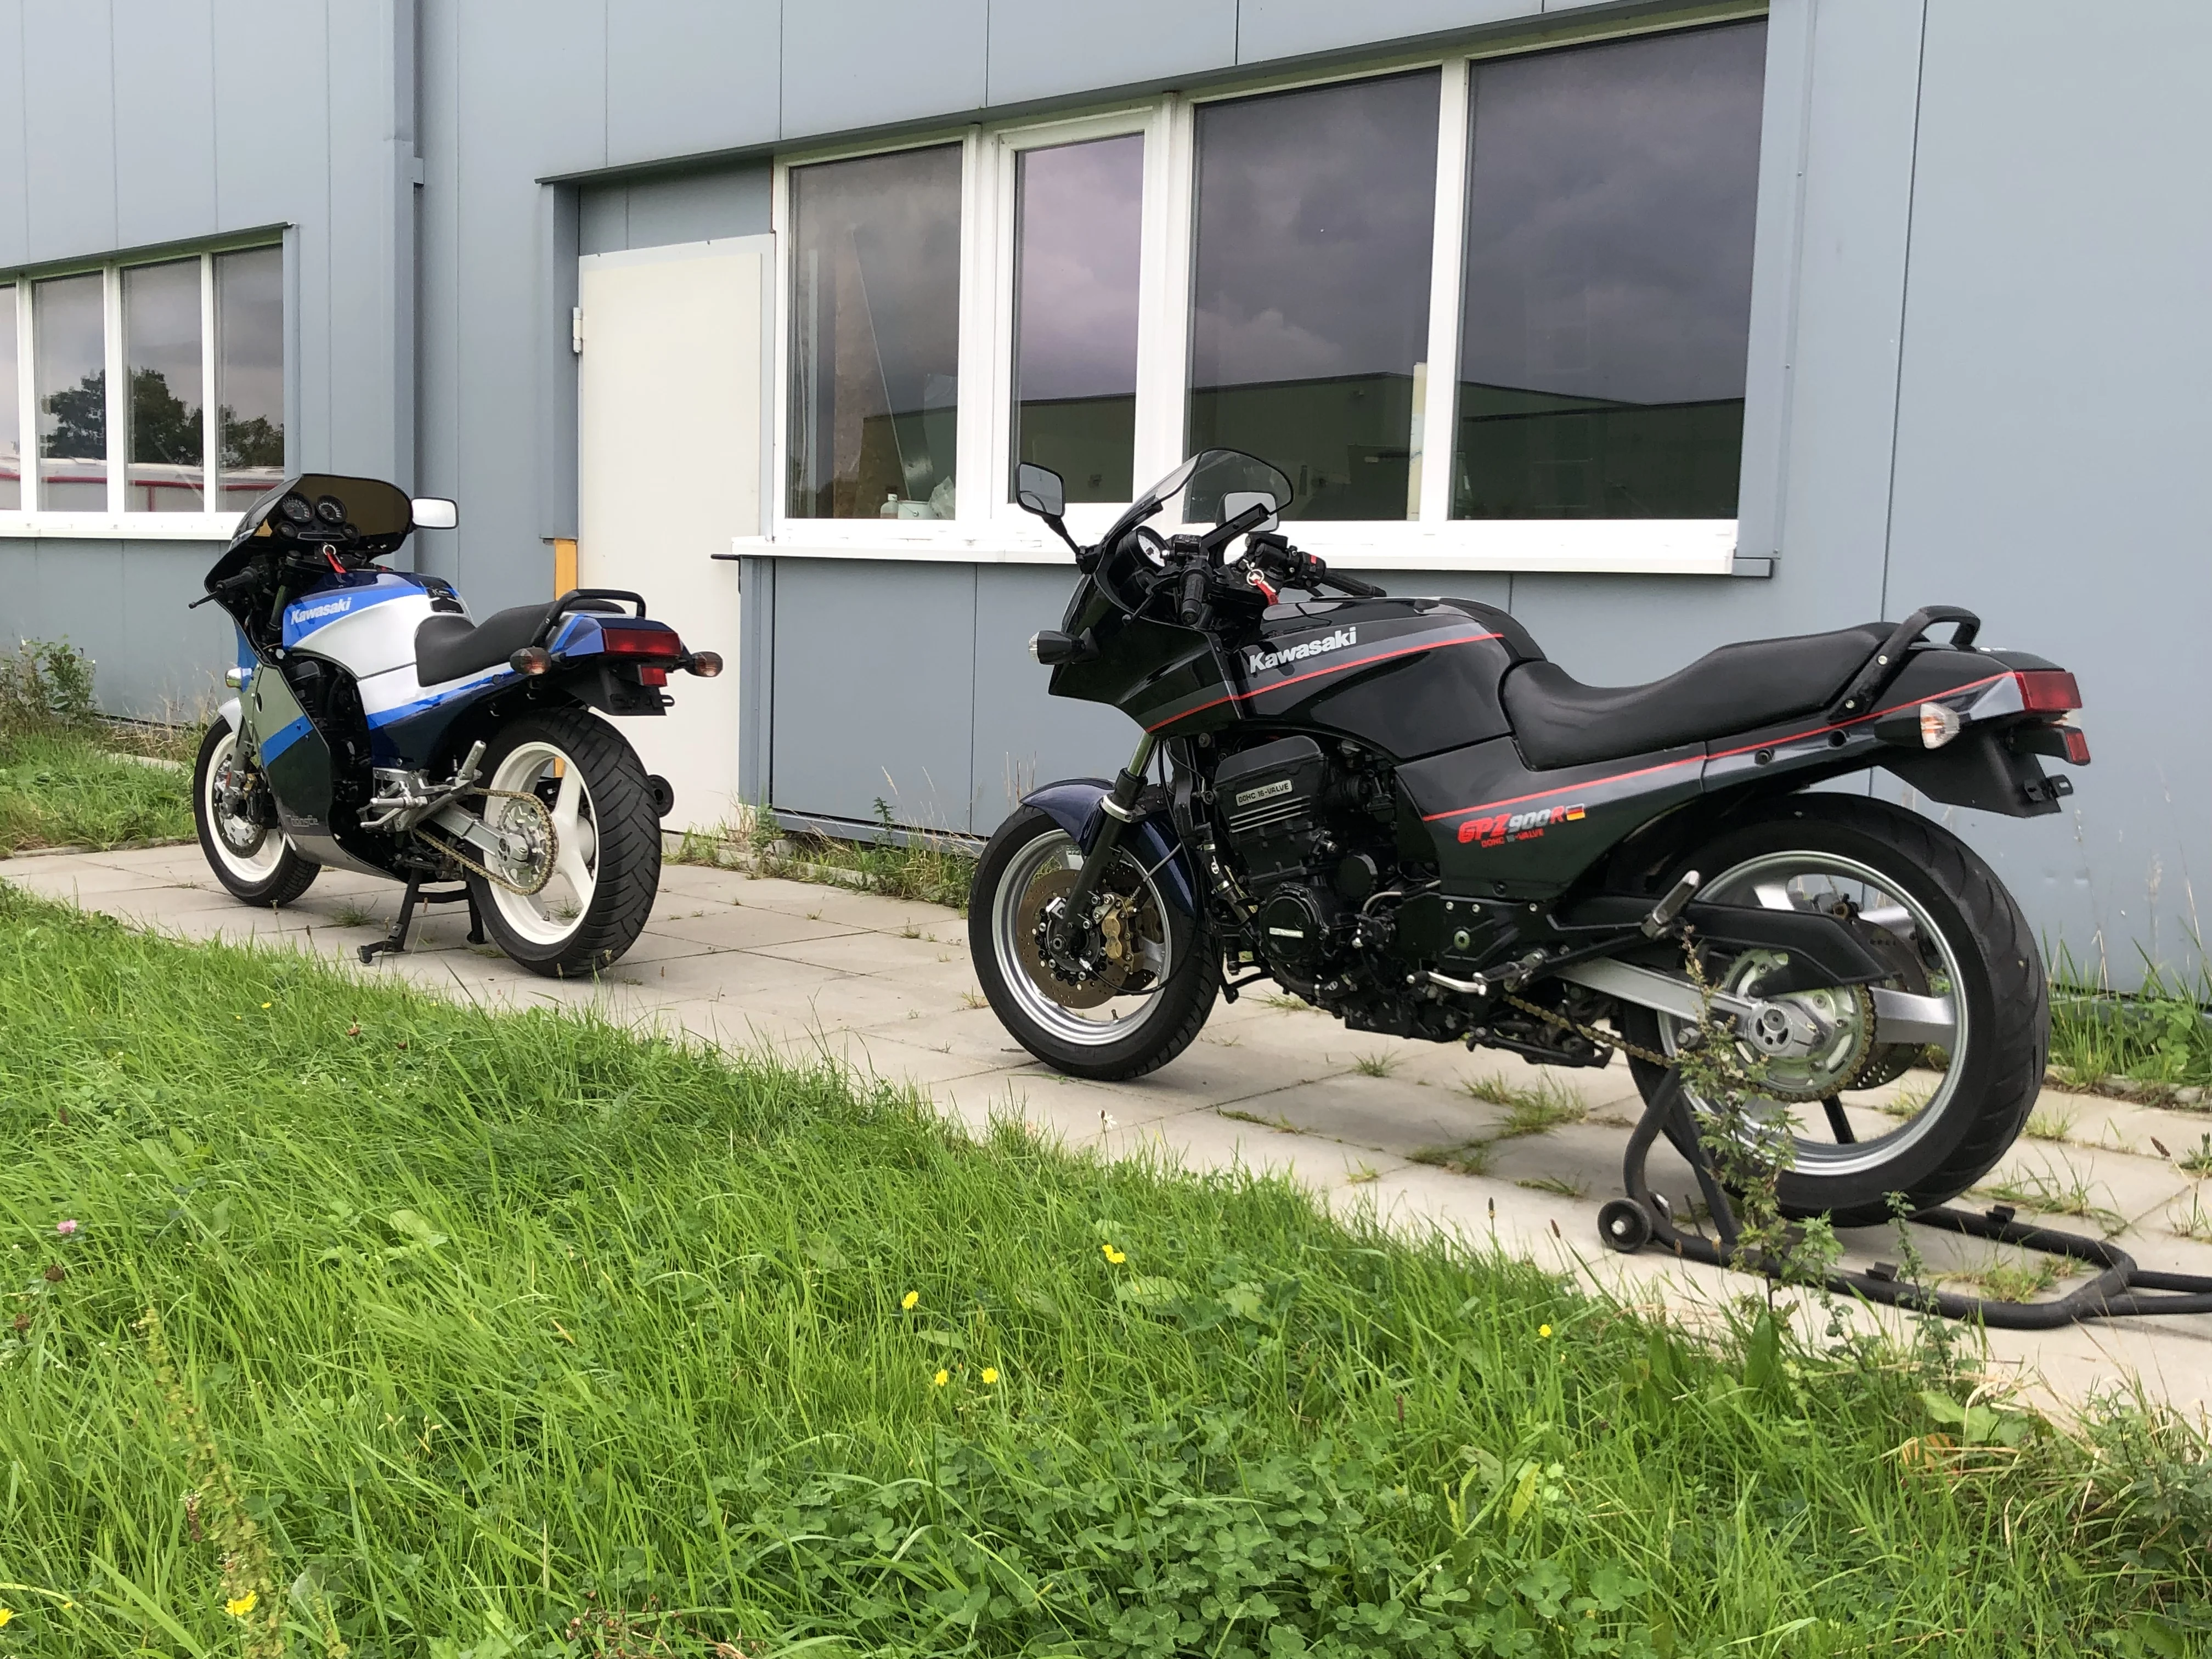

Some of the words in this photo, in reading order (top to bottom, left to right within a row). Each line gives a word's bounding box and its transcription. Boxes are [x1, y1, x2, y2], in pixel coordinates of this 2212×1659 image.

[290, 597, 352, 625] Kawasaki
[1249, 627, 1357, 674] Kawasaki
[1238, 792, 1256, 803] DOHC
[1257, 783, 1289, 797] 16-VALVE
